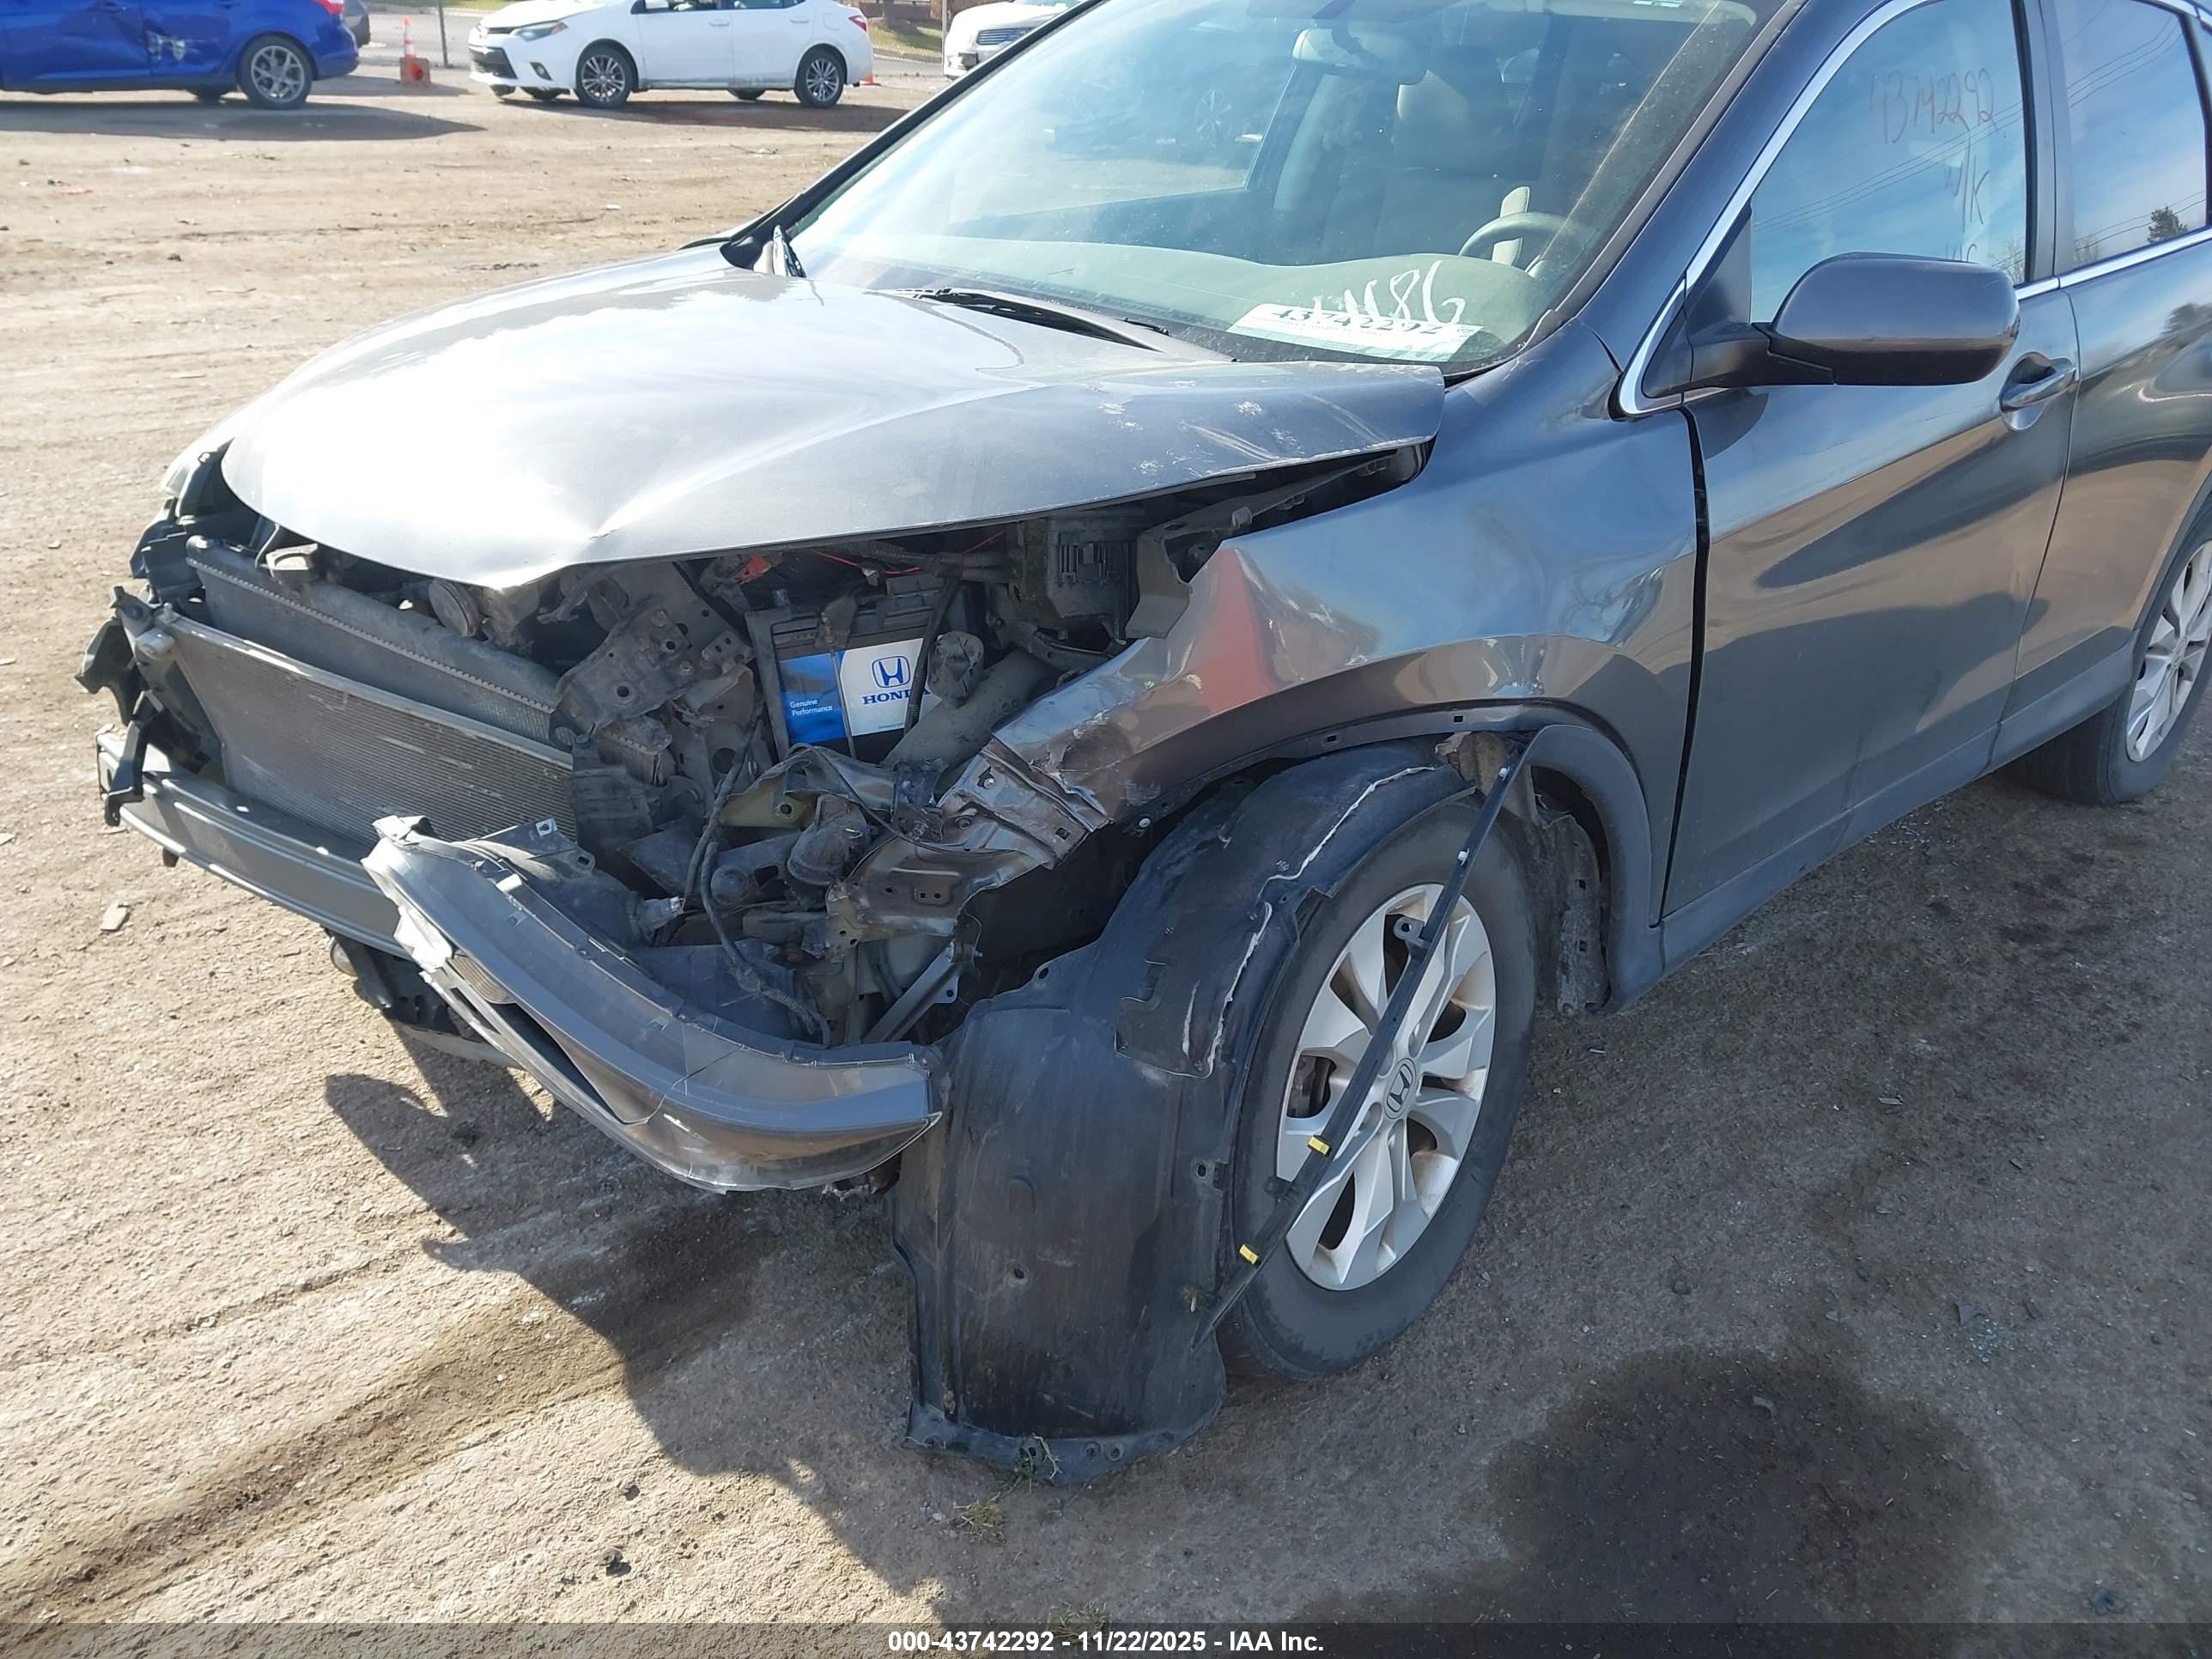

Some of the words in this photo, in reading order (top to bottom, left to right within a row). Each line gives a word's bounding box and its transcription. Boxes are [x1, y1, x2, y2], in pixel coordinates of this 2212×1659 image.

[861, 688, 932, 705] HON
[790, 699, 817, 708] Genuine
[791, 705, 833, 716] Performance
